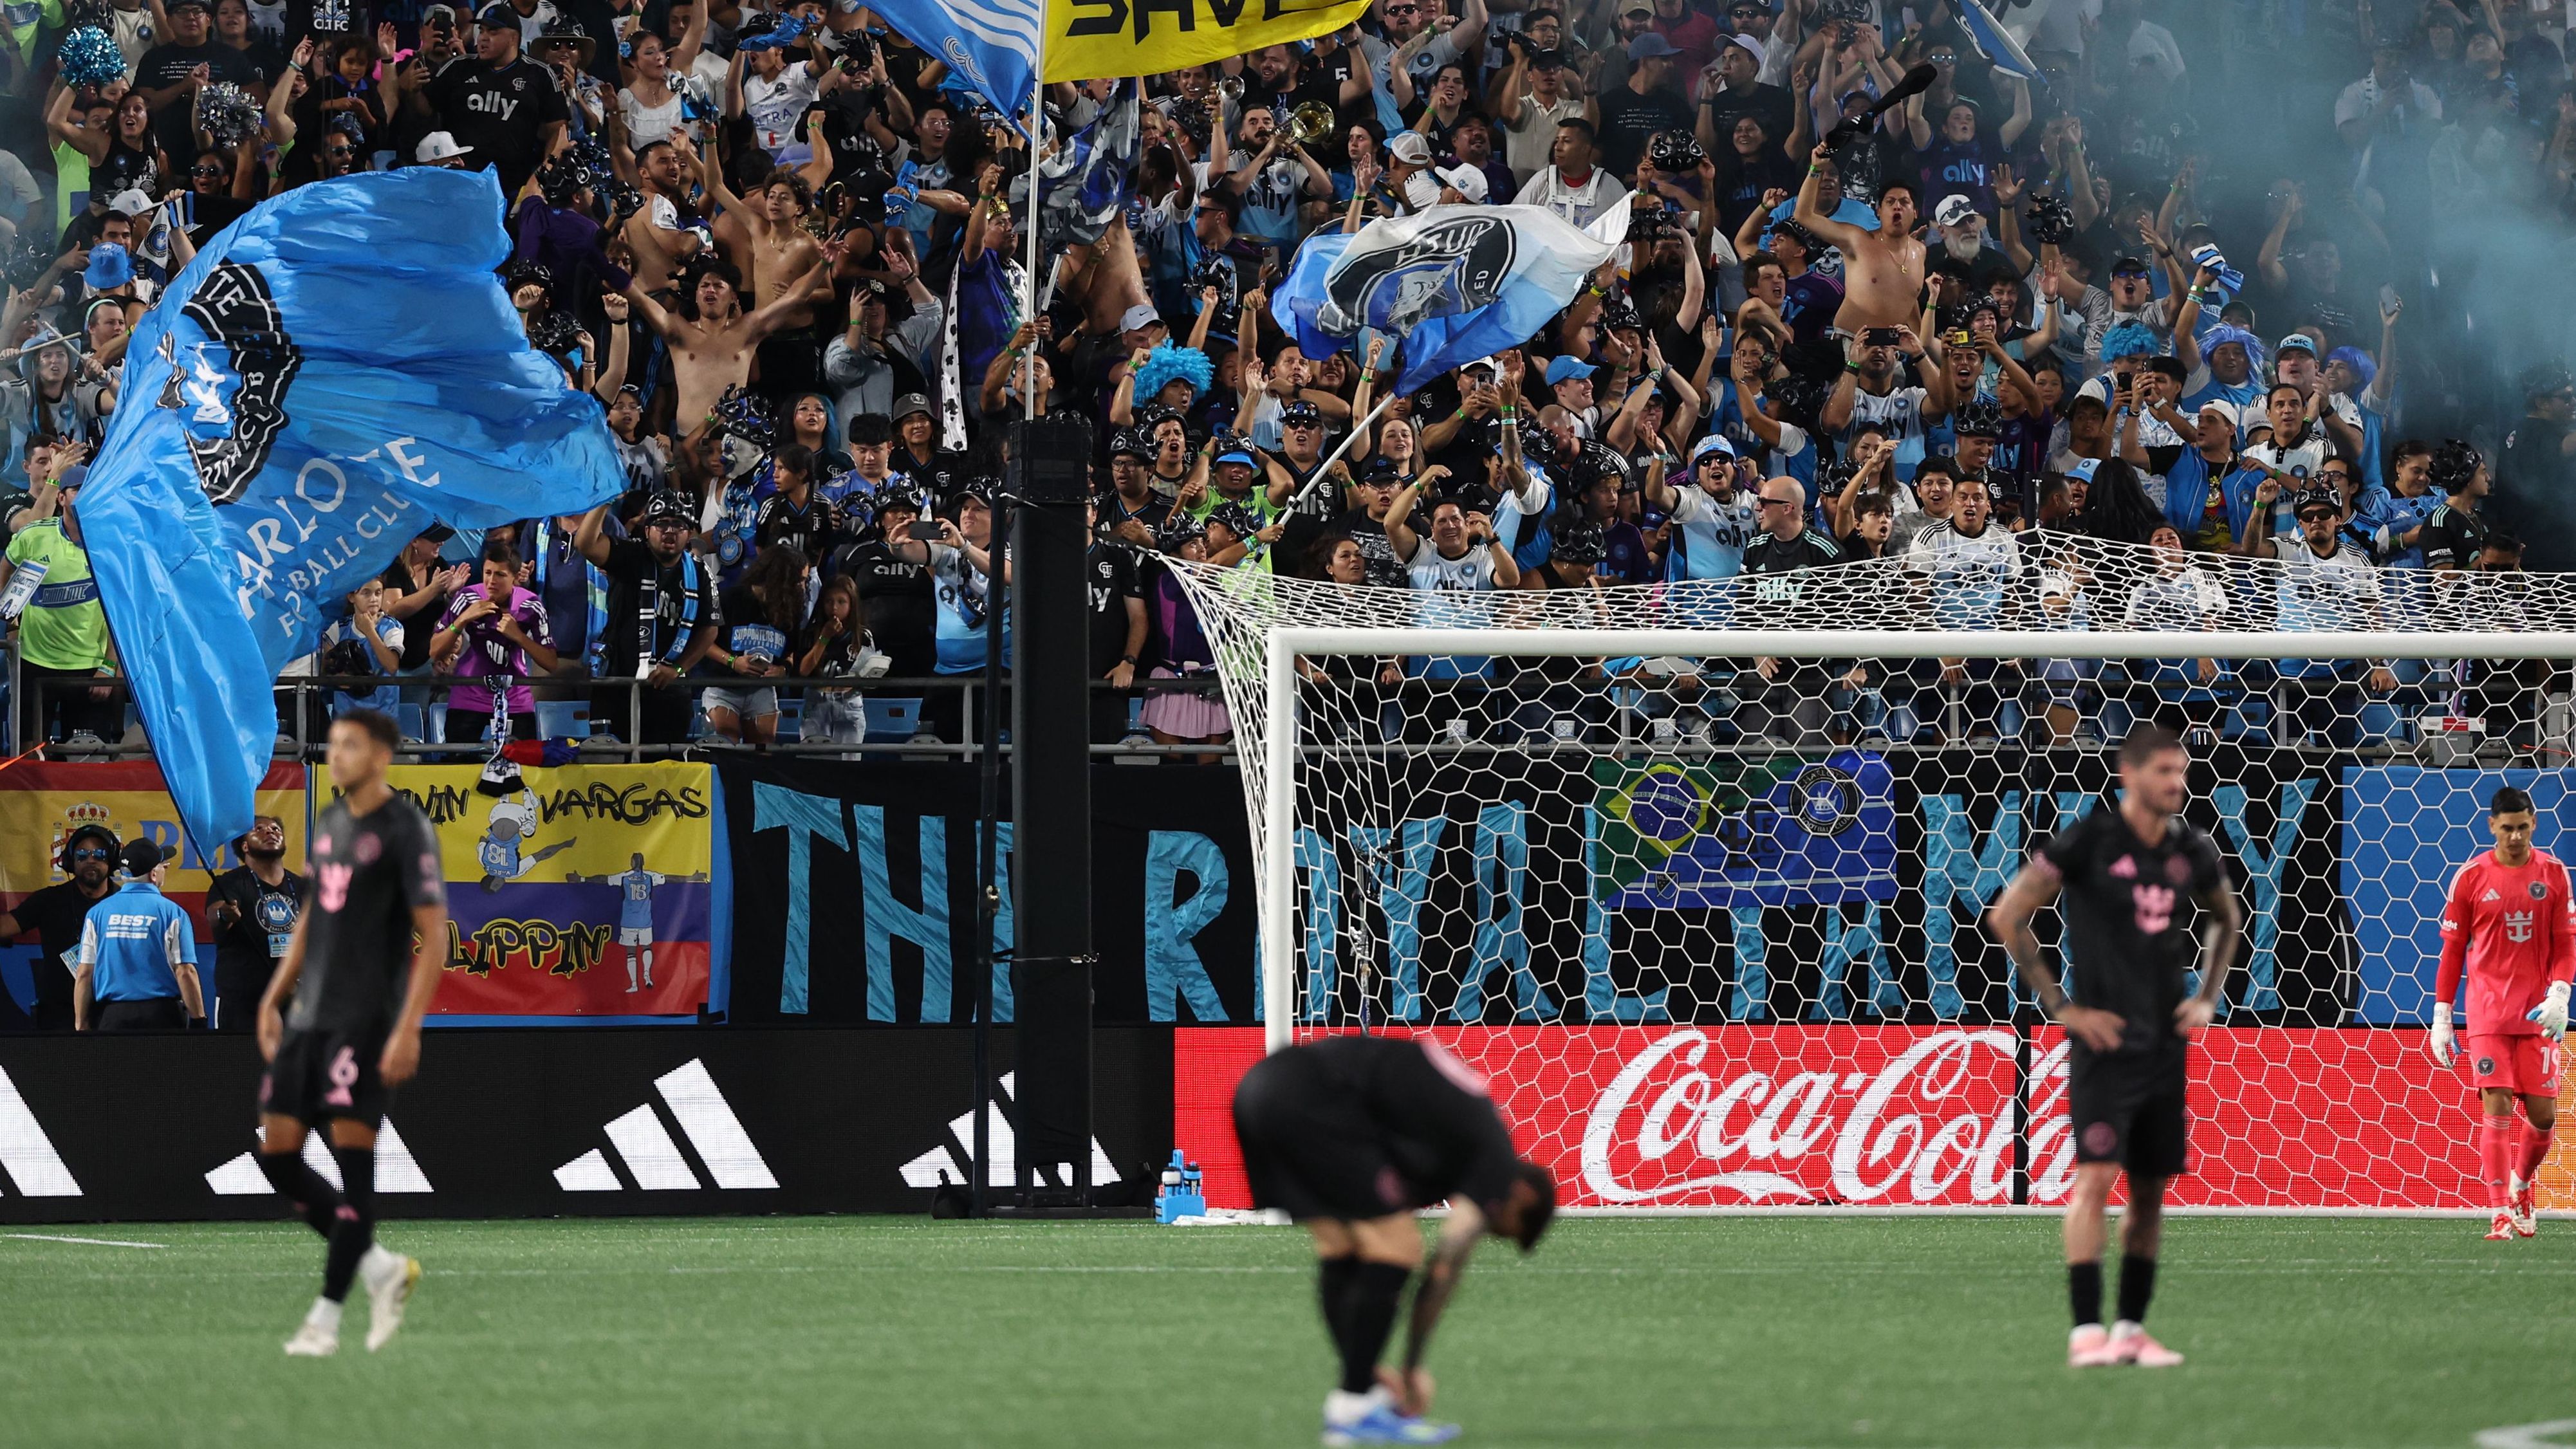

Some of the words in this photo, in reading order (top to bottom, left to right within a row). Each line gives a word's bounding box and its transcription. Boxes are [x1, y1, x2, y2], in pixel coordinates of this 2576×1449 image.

[467, 91, 519, 121] ally
[1943, 159, 1984, 186] ally
[874, 562, 918, 578] ally
[541, 781, 710, 826] VARGAS
[630, 883, 647, 901] 18
[108, 914, 158, 927] BEST
[328, 1045, 359, 1088] 6
